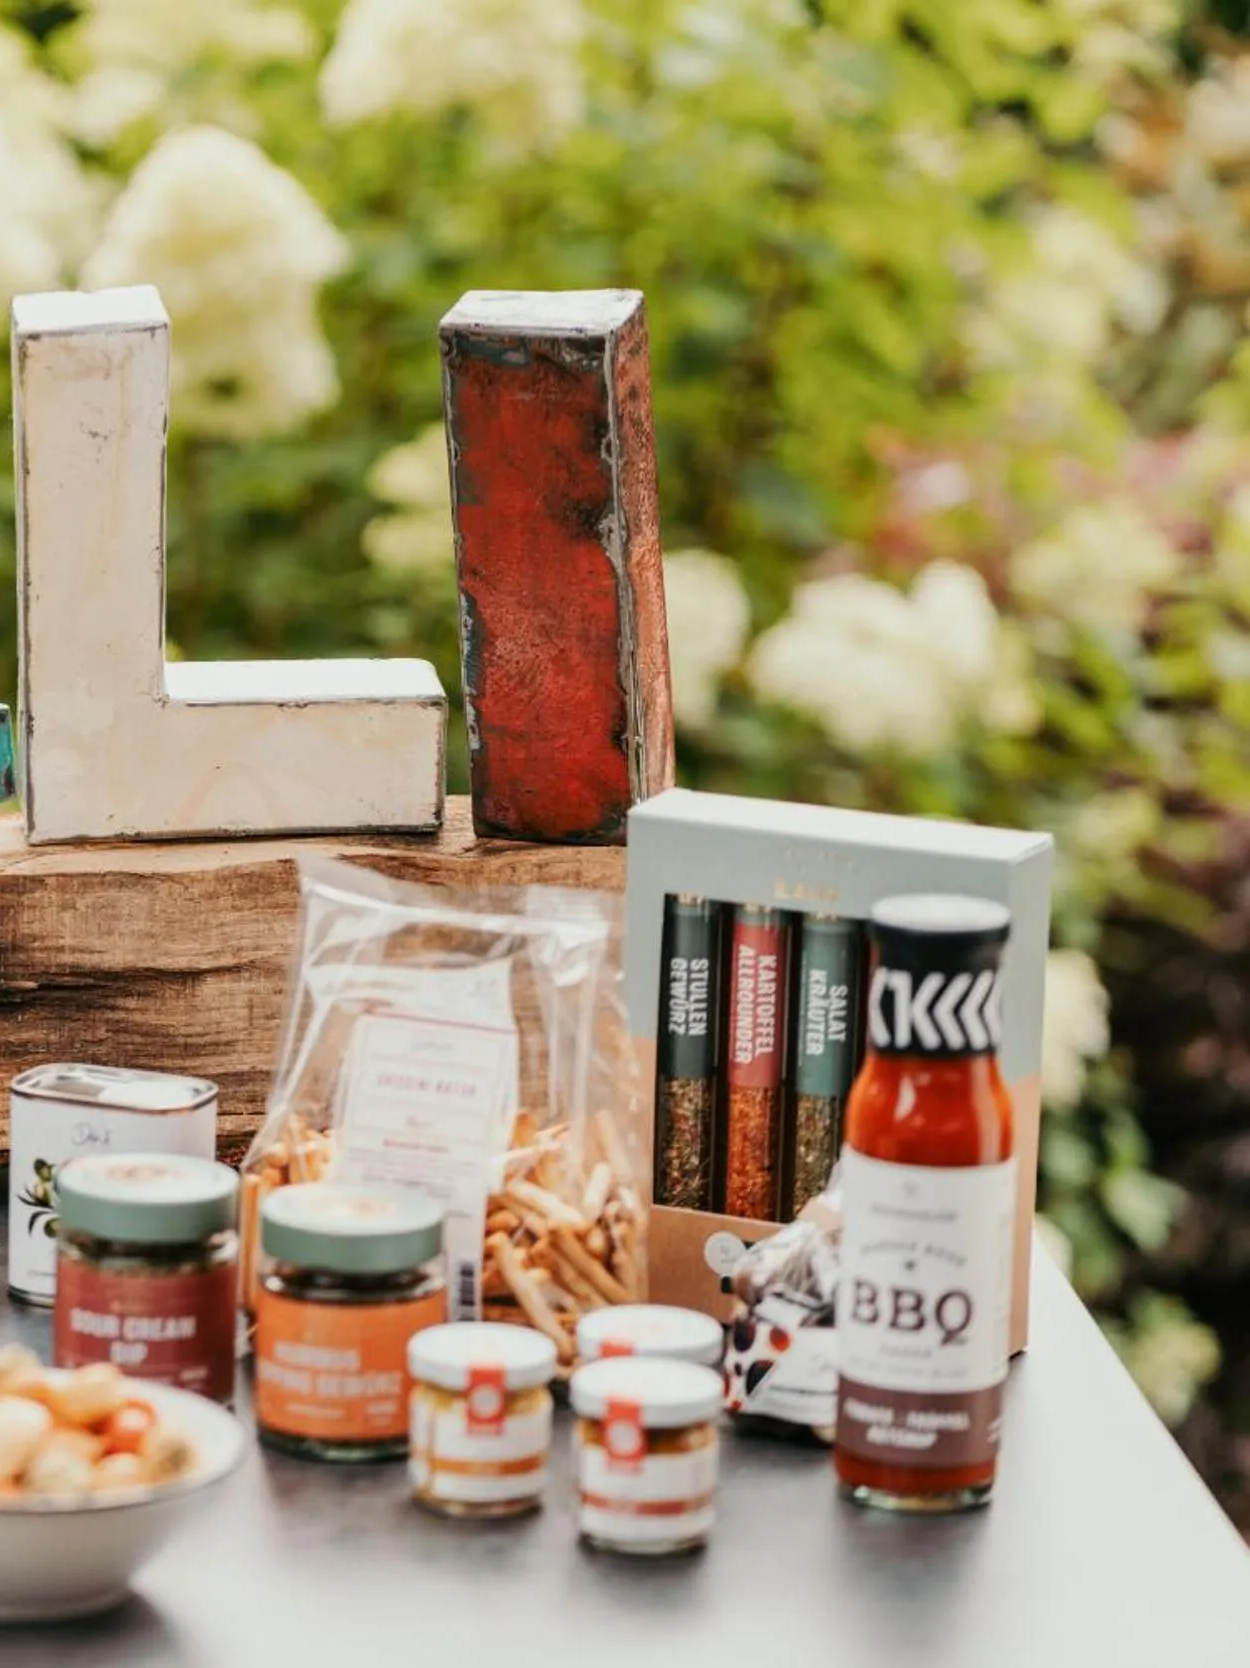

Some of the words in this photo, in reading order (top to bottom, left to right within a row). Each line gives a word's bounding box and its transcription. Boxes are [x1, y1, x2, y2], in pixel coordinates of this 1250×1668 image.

[668, 957, 688, 1035] GEWÜRZ
[688, 957, 709, 1036] STULLEN
[735, 944, 755, 1064] ALLROUNDER
[755, 954, 777, 1057] KARTOFFEL
[806, 969, 828, 1056] KRÄUTER
[828, 985, 848, 1042] SALAT
[851, 1276, 973, 1346] BBQ
